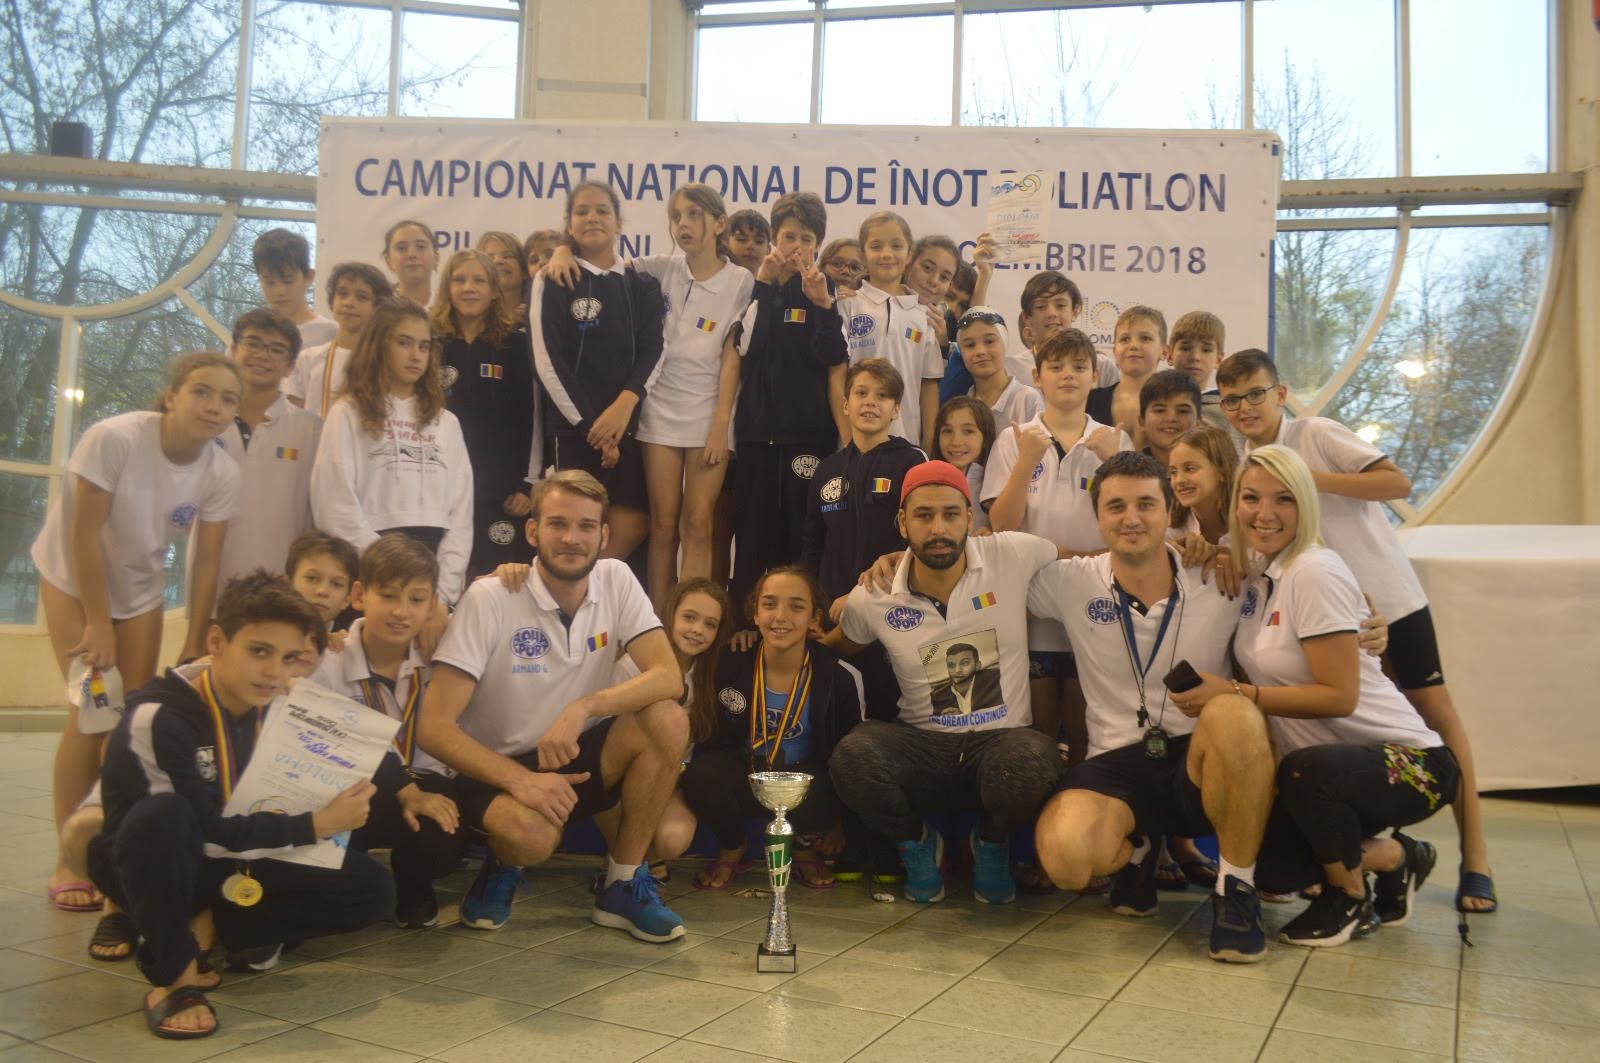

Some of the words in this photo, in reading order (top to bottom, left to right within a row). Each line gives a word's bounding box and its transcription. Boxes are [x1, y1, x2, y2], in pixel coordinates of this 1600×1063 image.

[354, 157, 596, 199] CAMPIONAT
[825, 166, 877, 205] DE
[887, 159, 988, 208] ÎNOT
[1000, 169, 1226, 213] LIATLON
[1126, 244, 1207, 275] 2018
[941, 714, 969, 727] DREAM
[969, 704, 1008, 727] CONTINUES
